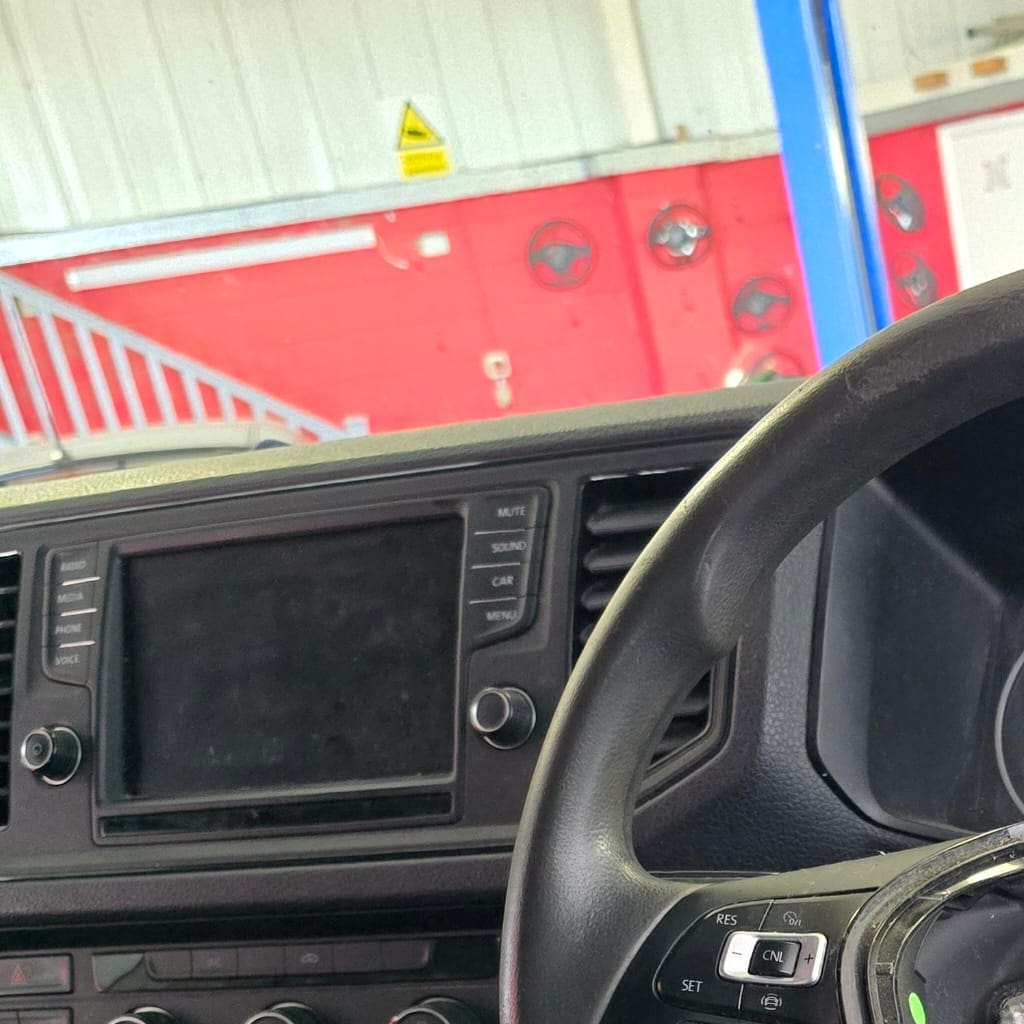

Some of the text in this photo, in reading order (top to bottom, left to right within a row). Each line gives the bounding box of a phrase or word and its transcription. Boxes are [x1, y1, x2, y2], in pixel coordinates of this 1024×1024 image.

[497, 506, 526, 518] MUTE
[491, 541, 527, 554] SOUND
[491, 576, 514, 588] CAR
[486, 611, 517, 621] MENU
[55, 654, 80, 666] VOICE
[716, 913, 738, 926] RES
[762, 949, 784, 963] CNL
[681, 979, 703, 993] SET
